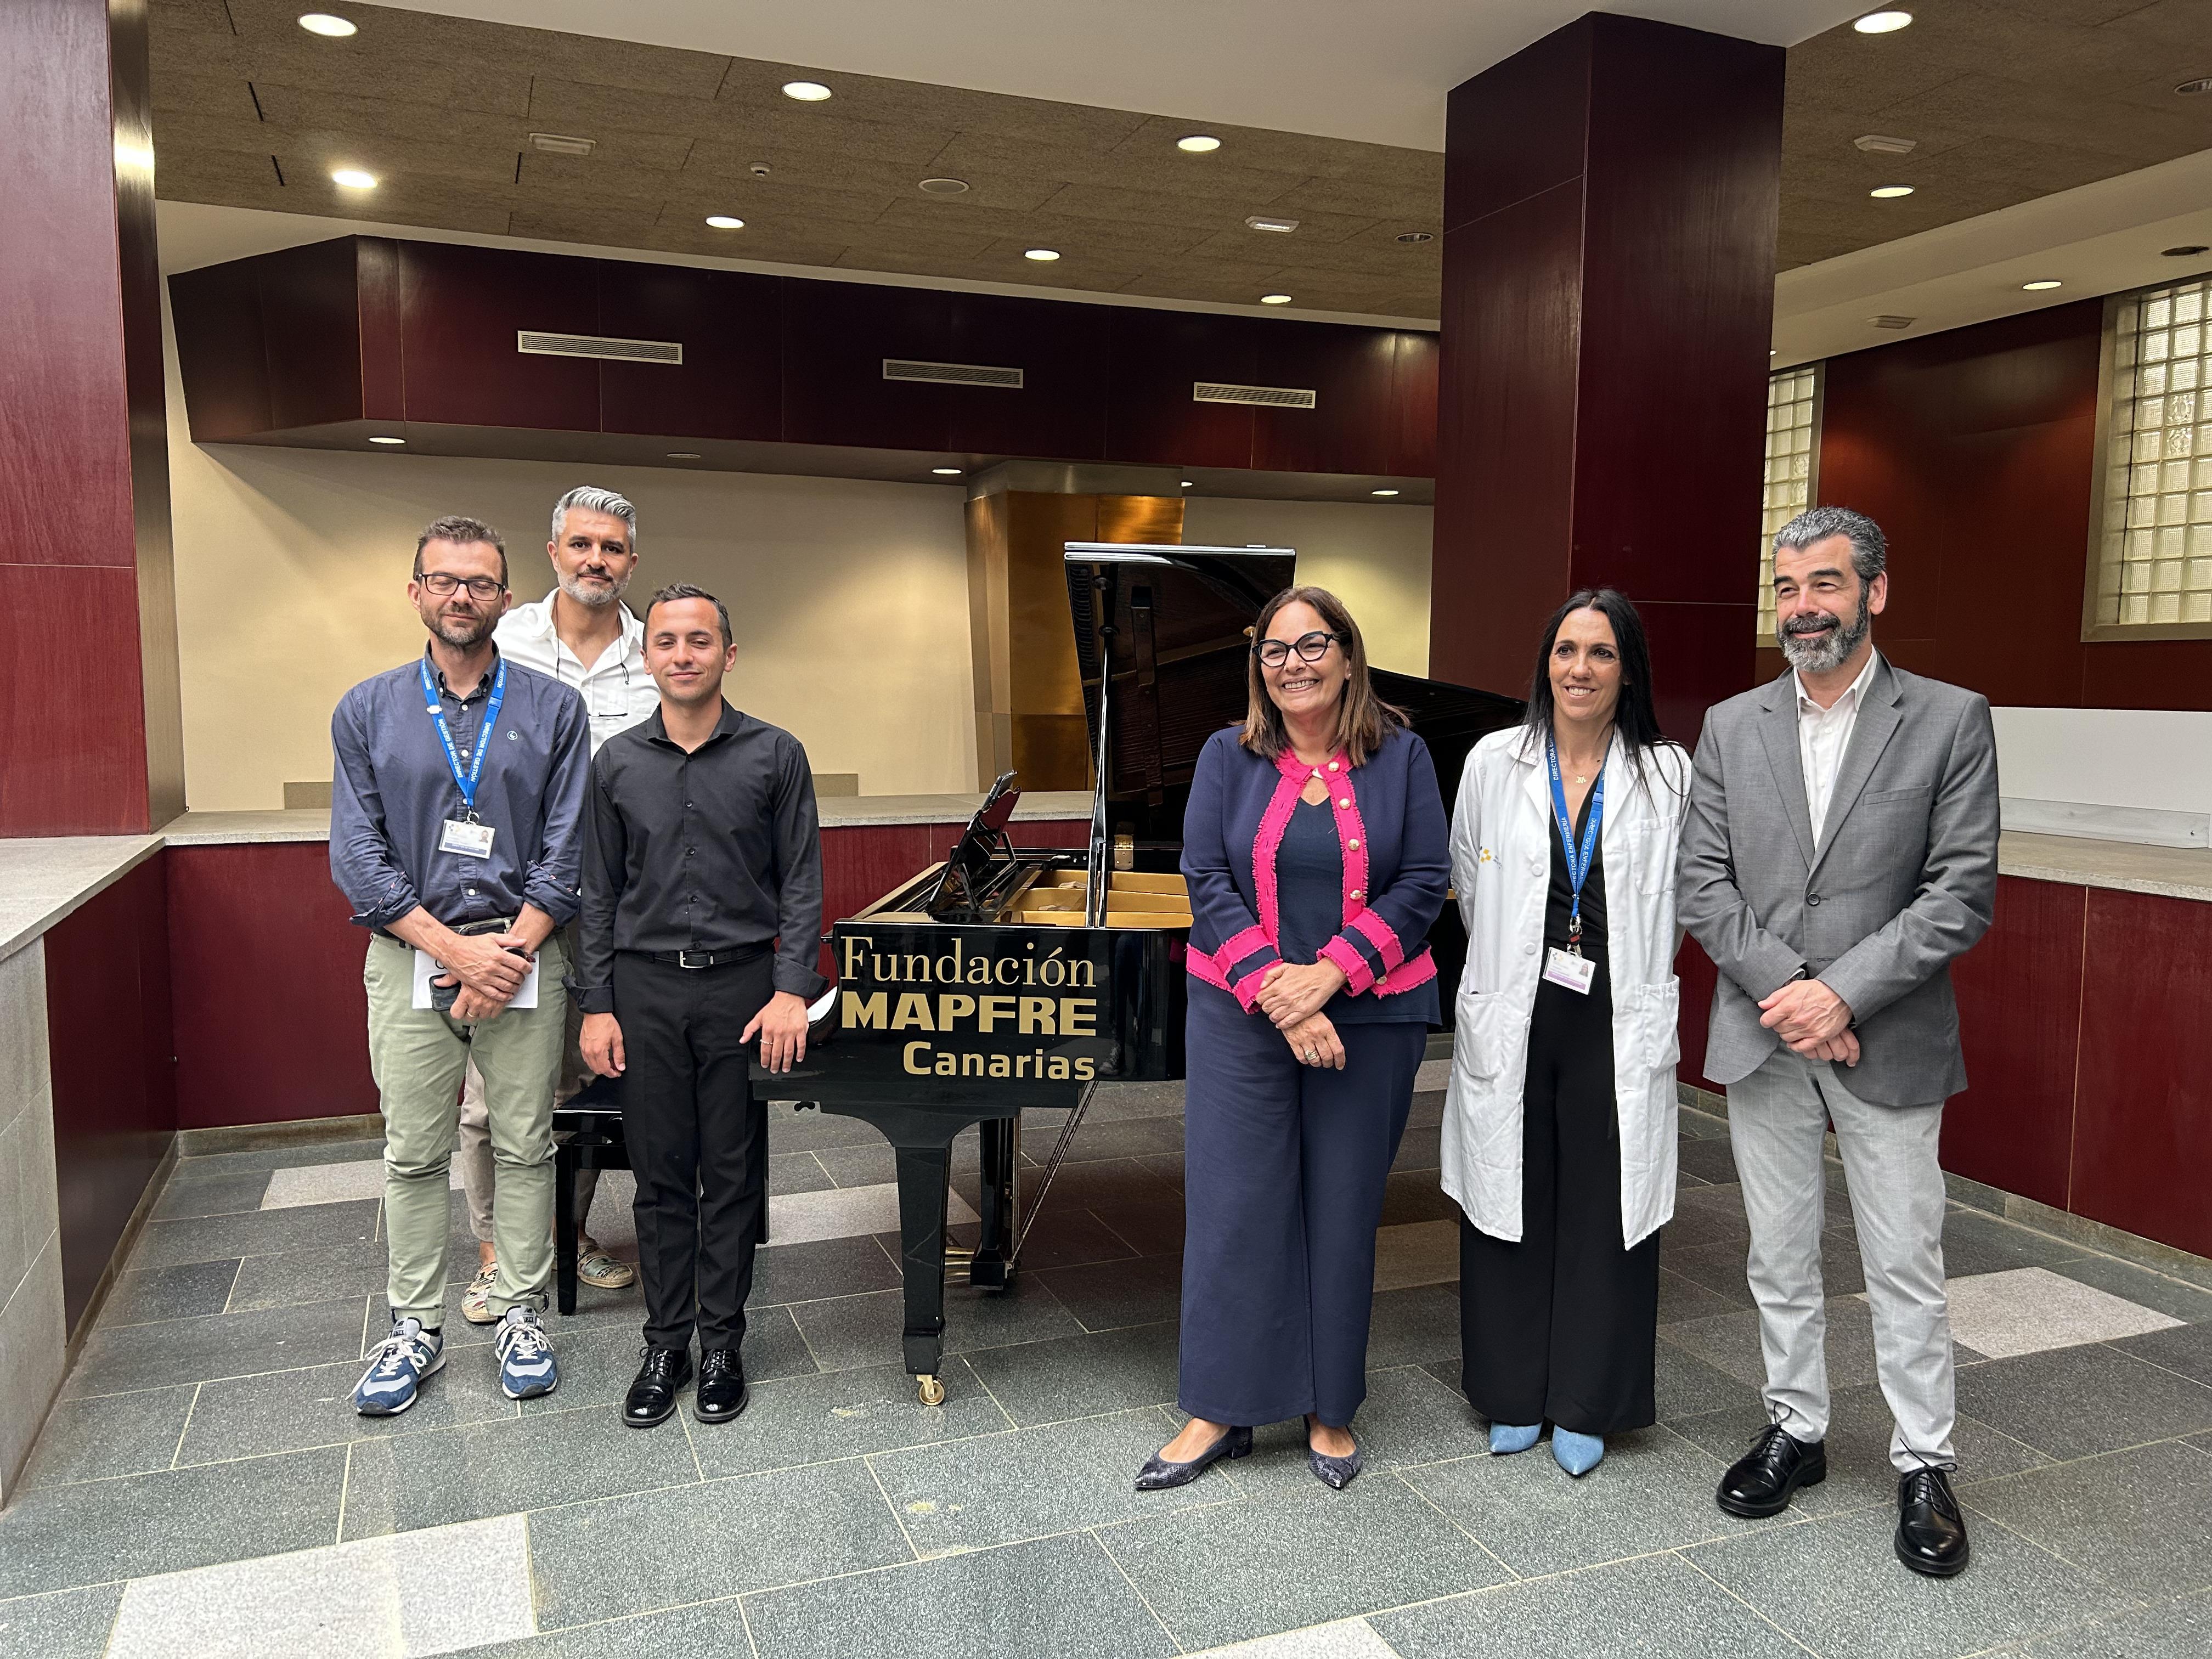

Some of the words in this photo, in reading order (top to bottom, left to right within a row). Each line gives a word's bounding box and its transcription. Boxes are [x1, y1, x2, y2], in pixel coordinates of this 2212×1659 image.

[438, 719, 451, 742] GESTIÓN
[478, 722, 491, 748] DIRECTOR
[447, 742, 454, 751] DE
[476, 749, 483, 757] DE
[450, 750, 464, 778] DIRECTOR
[470, 757, 481, 782] GESTIÓN
[1549, 748, 1559, 781] DIRECTORA
[1584, 817, 1597, 850] DIRECTORA
[840, 936, 1097, 988] Fundación
[842, 991, 1097, 1036] MAPFRE
[904, 1041, 1096, 1081] Canarias
